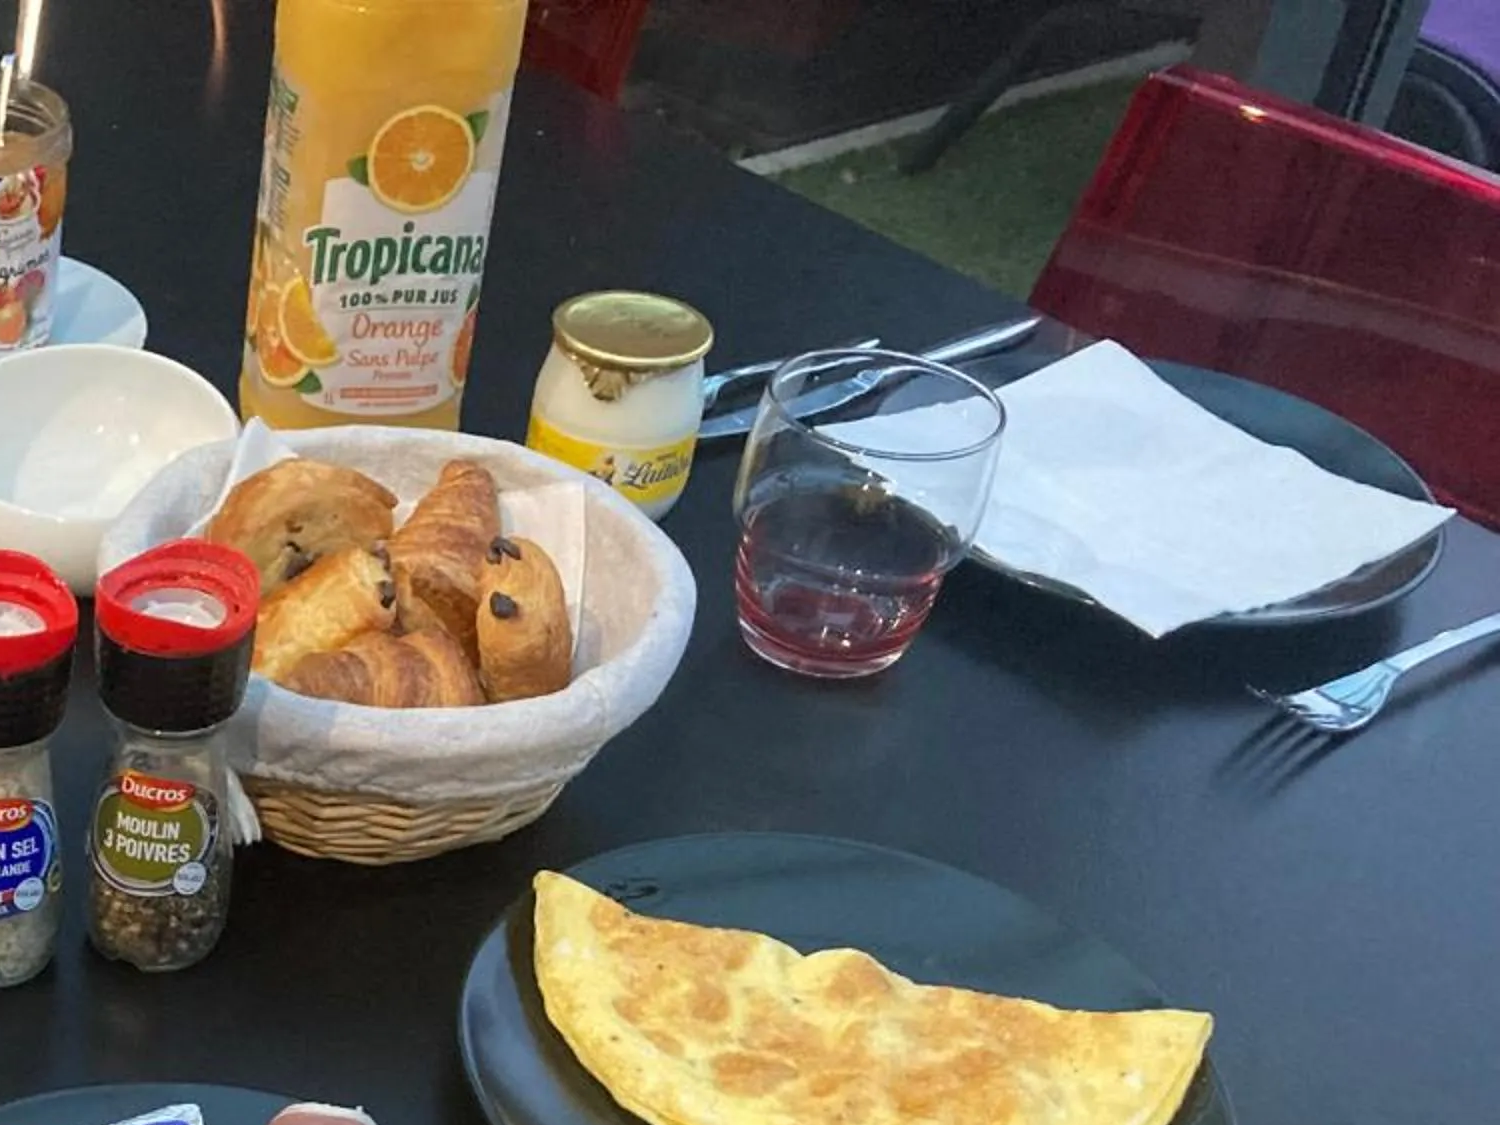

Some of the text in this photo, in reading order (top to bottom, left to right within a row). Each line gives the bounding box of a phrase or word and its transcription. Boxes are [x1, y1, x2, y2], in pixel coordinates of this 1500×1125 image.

[306, 221, 484, 285] Tropicana
[339, 289, 459, 308] 100% PUR JUS
[352, 312, 444, 347] Orange
[347, 349, 389, 367] Sans
[120, 775, 187, 802] Ducros
[116, 811, 180, 840] MOULIN
[11, 836, 40, 859] SEL
[103, 828, 191, 863] 3 POIVRES
